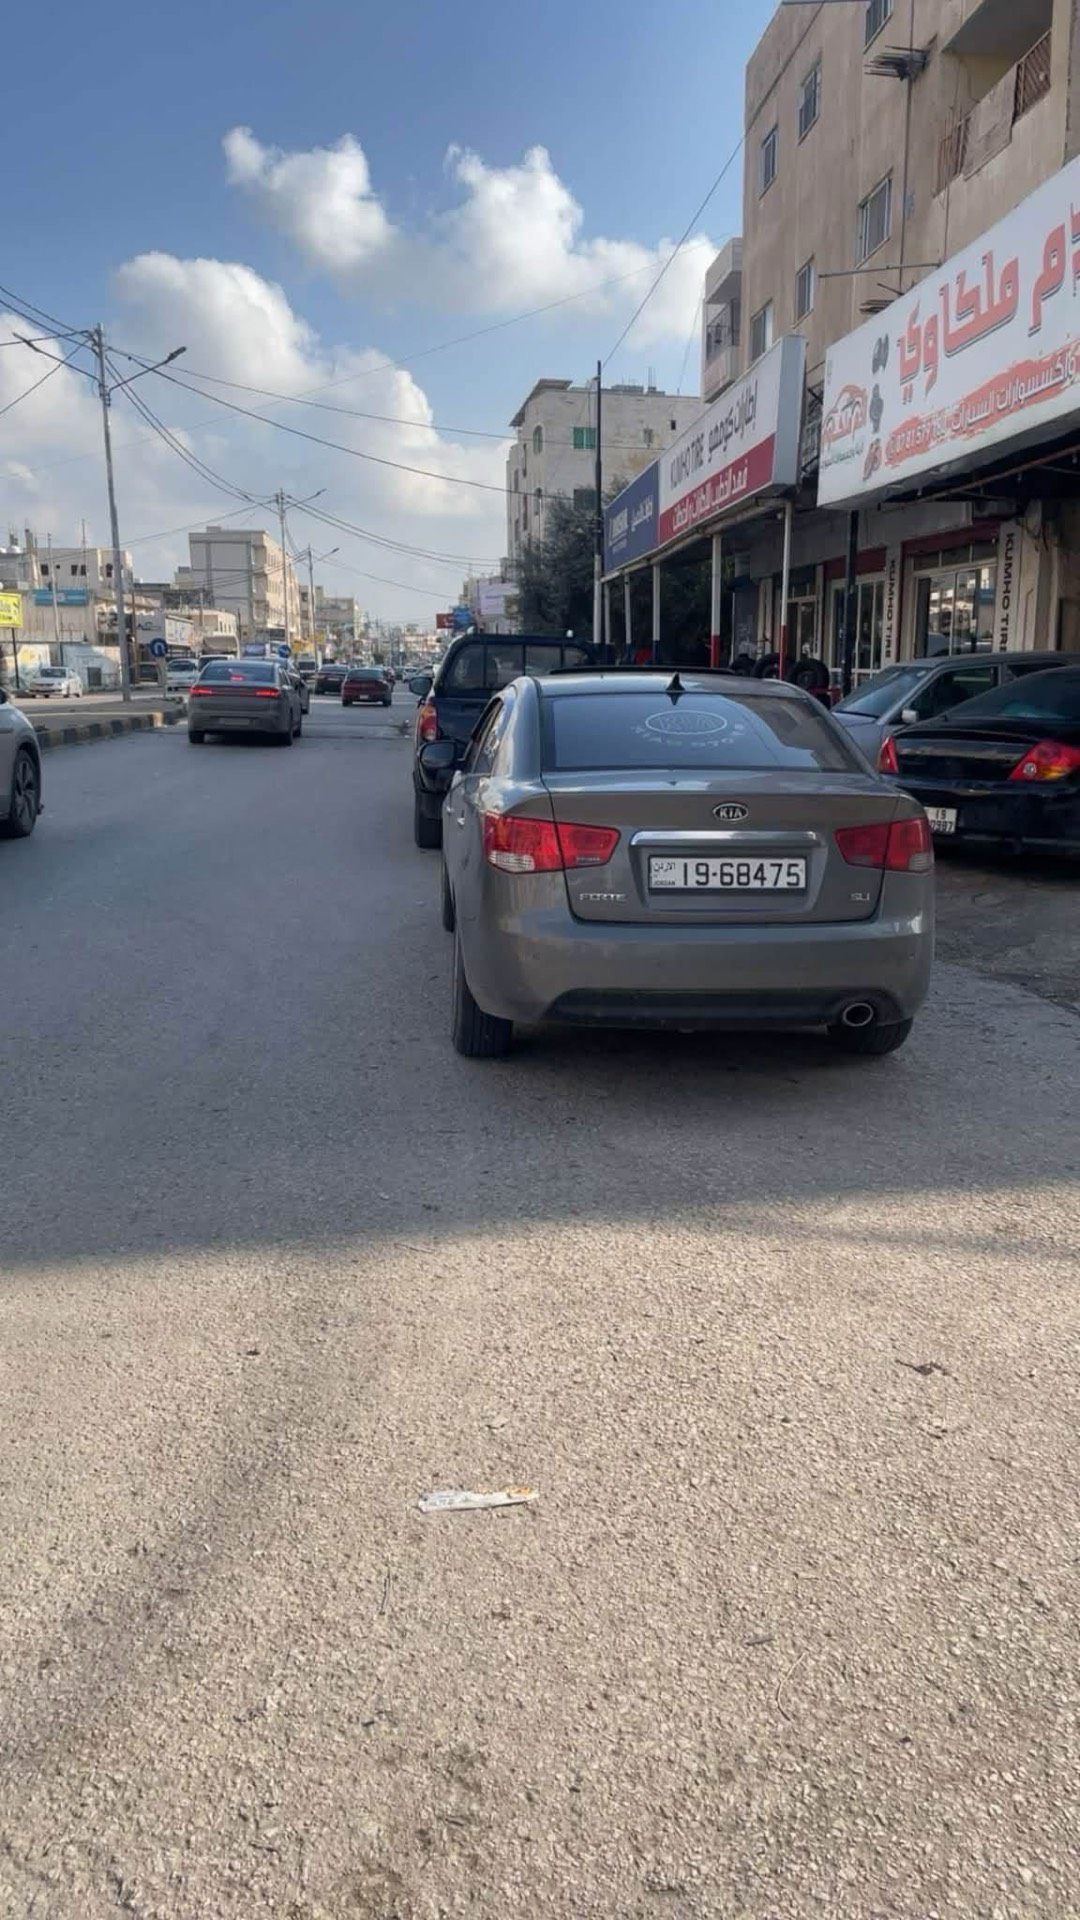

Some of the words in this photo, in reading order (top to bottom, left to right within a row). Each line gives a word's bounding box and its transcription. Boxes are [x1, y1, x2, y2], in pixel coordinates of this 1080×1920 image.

[897, 251, 1019, 405] ملكاوي
[886, 560, 896, 620] KUMHO
[1002, 532, 1015, 611] KUMHO
[720, 807, 743, 818] KIA
[683, 862, 801, 887] 19-68475
[579, 892, 627, 901] FORTE
